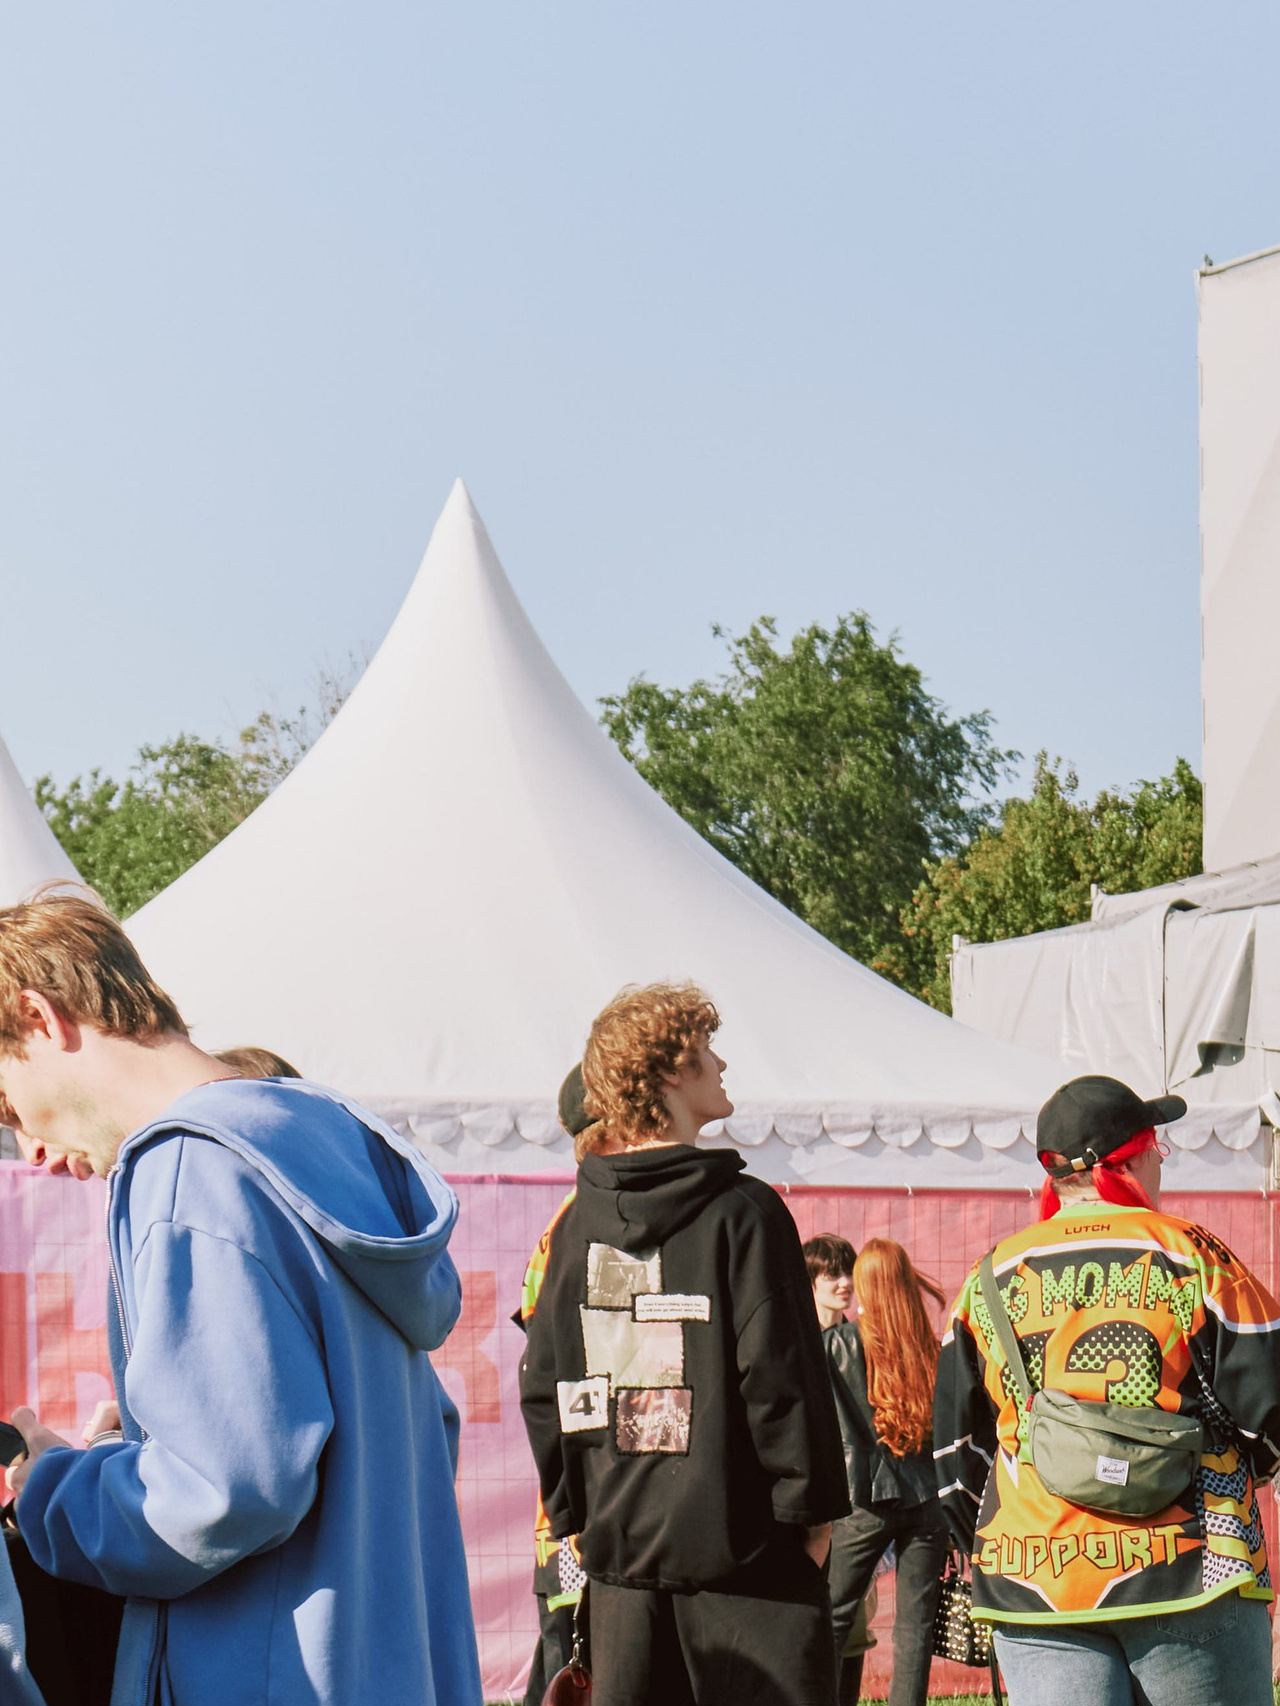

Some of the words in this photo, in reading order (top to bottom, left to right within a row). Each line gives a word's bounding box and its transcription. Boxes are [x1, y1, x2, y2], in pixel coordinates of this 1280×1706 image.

[1064, 1223, 1111, 1235] LUTCH
[1041, 1261, 1196, 1333] MOMMA
[978, 1523, 1186, 1580] SUPPORT
